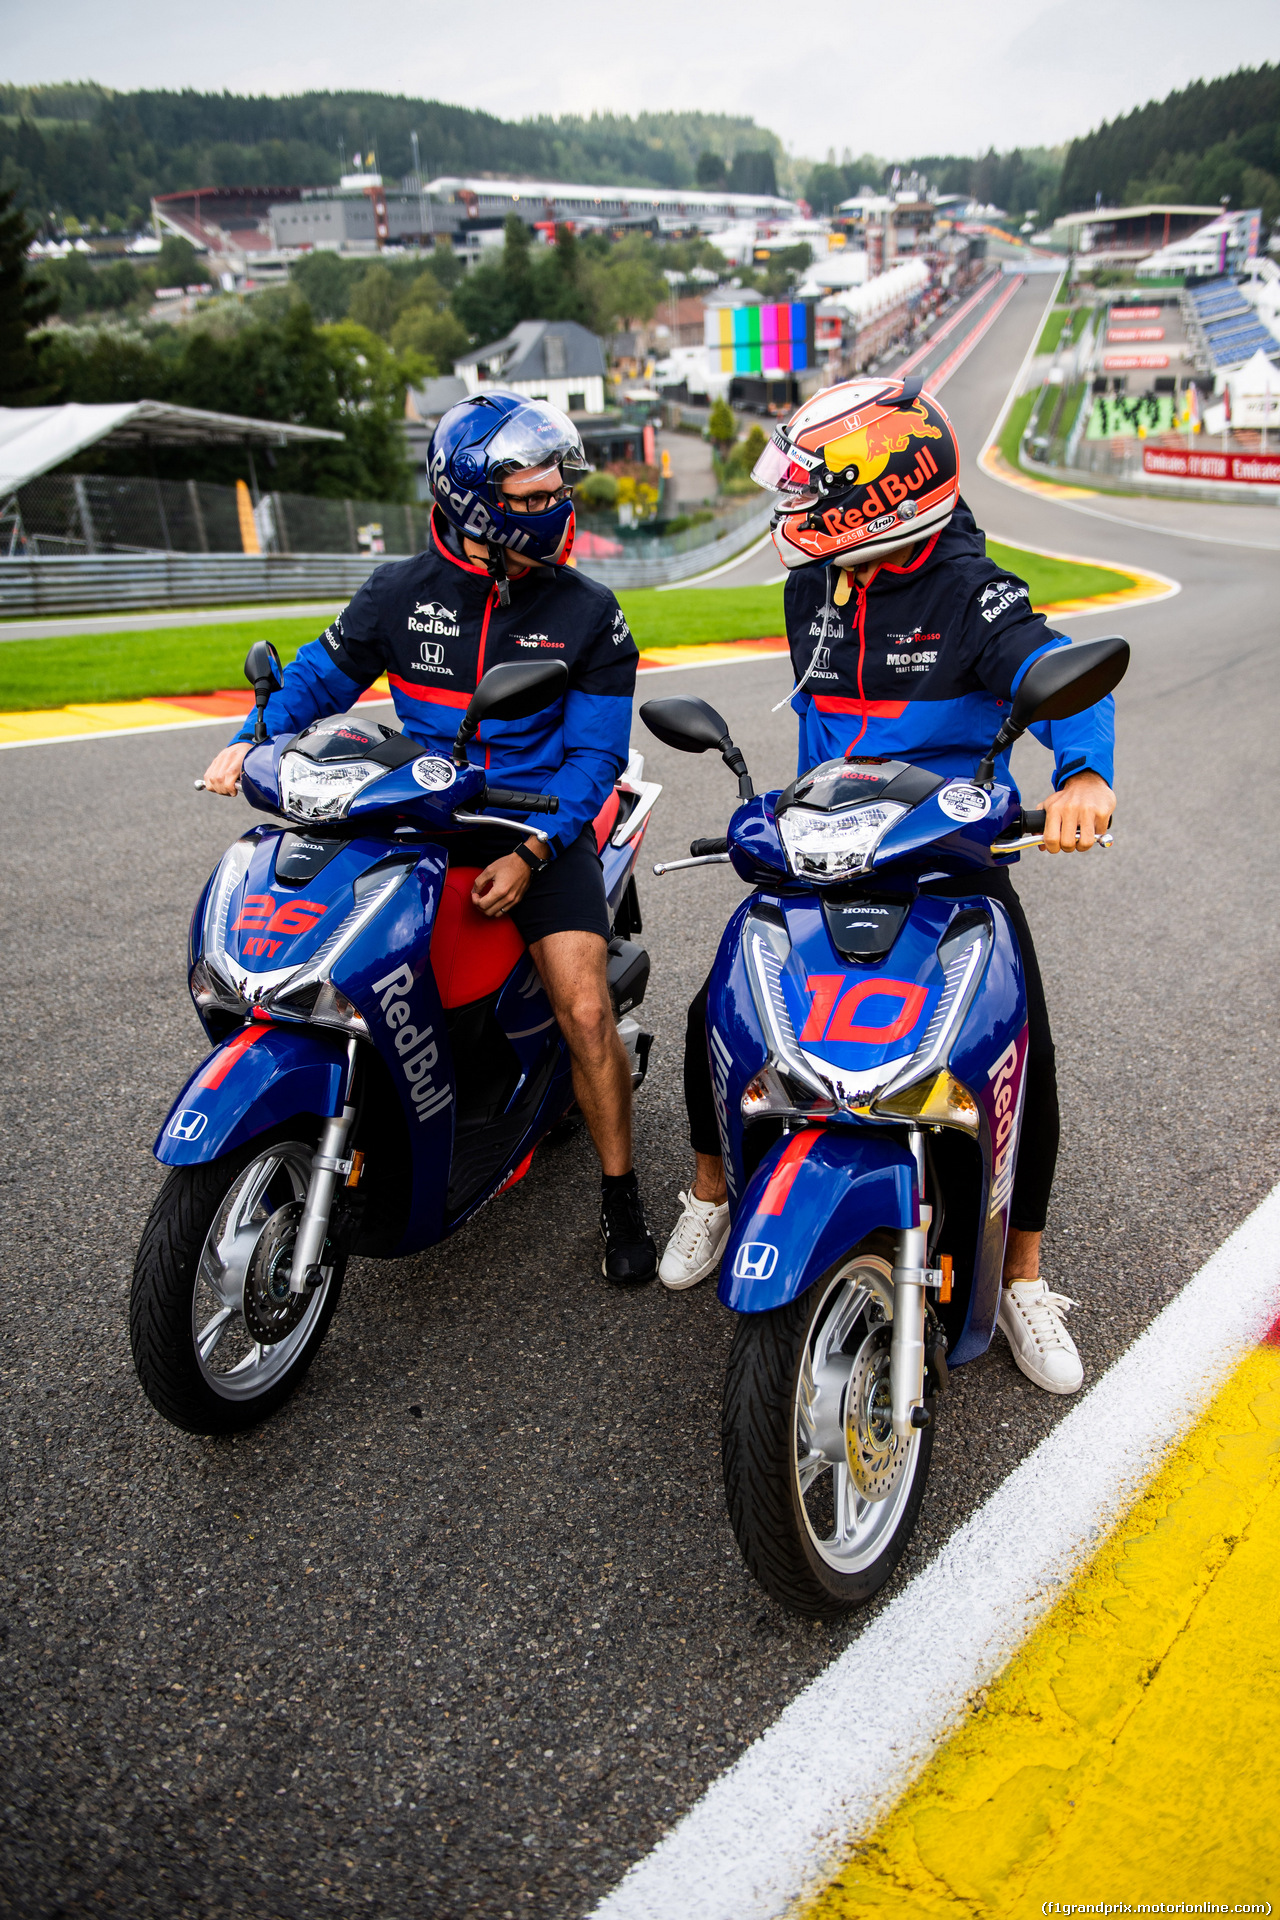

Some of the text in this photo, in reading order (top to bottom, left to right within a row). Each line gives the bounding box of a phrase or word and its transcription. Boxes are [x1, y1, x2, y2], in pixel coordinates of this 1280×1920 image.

[790, 449, 806, 464] Mobil
[822, 446, 939, 537] Red Bull
[430, 447, 530, 552] Red Bull
[870, 517, 893, 532] Arai
[981, 587, 1029, 623] Red Bull
[408, 616, 460, 637] Red Bull
[827, 624, 844, 638] Bull
[520, 638, 565, 648] Toro Rosso
[914, 633, 941, 642] Rosso
[886, 651, 938, 665] MOOSE
[410, 662, 454, 676] HONDA
[337, 729, 368, 743] Rosso
[841, 771, 879, 781] Rosso
[946, 790, 984, 804] MOPED
[289, 842, 324, 851] HONDA
[230, 894, 328, 935] 26
[842, 907, 889, 915] HONDA
[242, 937, 284, 958] KVY
[800, 974, 929, 1044] 10
[371, 962, 453, 1122] Red Bull
[987, 1039, 1019, 1220] Red Bull
